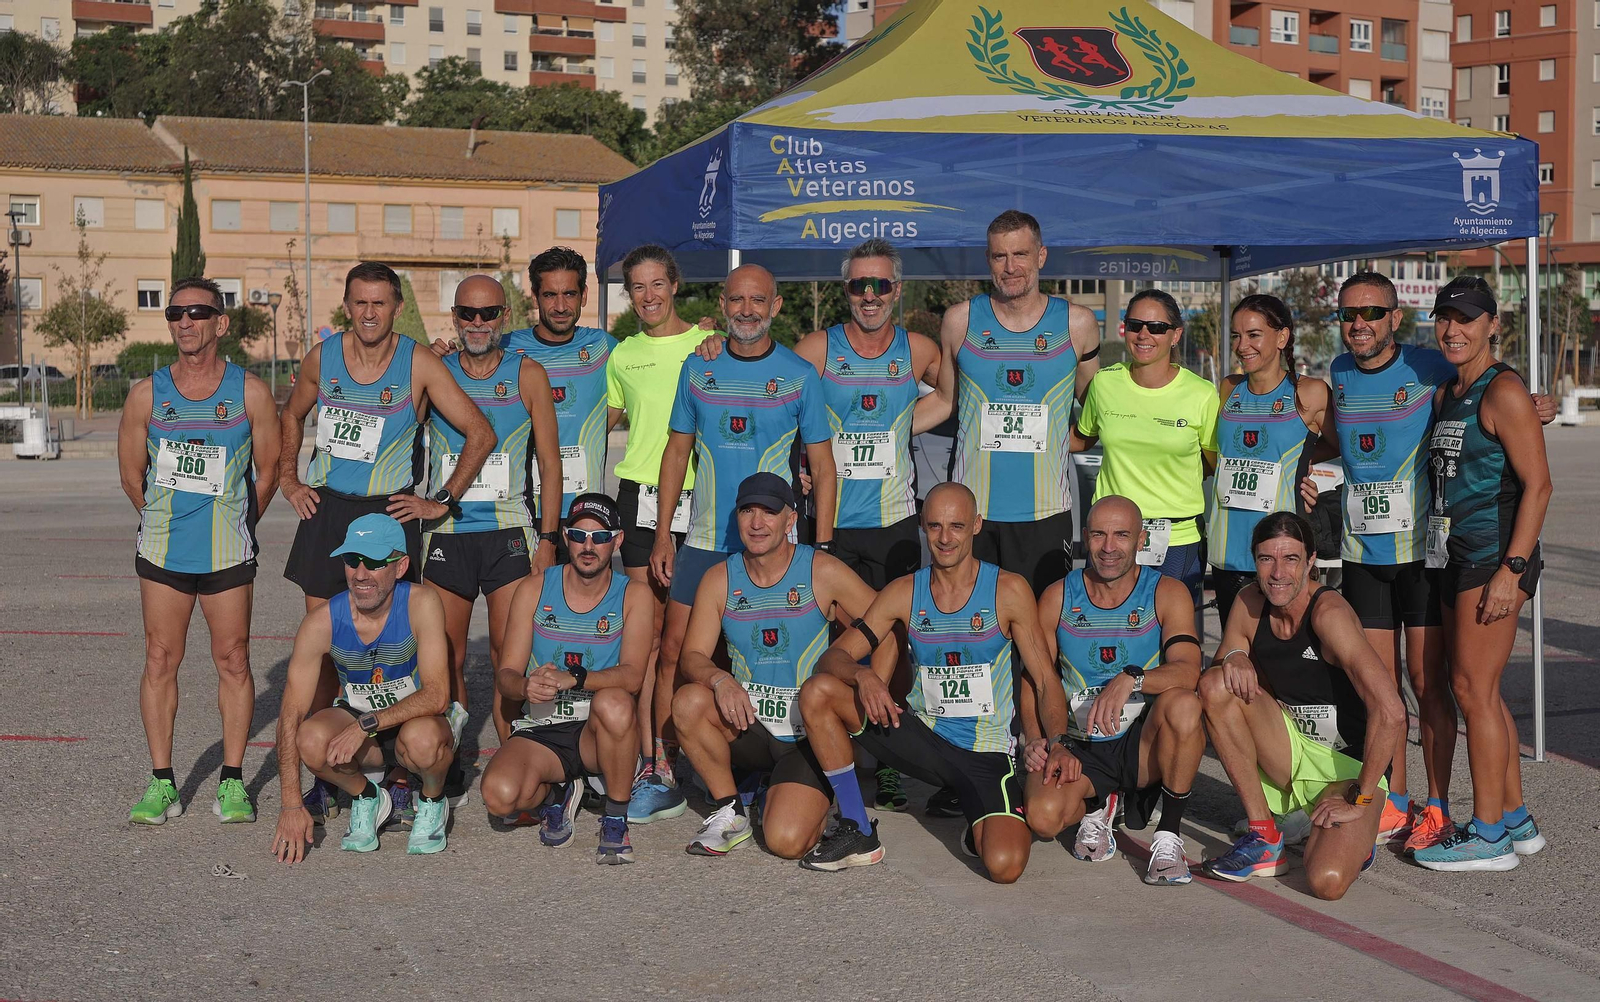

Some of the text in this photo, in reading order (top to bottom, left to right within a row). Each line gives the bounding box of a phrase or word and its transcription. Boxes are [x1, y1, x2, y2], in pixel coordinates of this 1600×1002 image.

[1017, 114, 1127, 126] VETERANOS
[1053, 108, 1180, 122] CLUB ATLETAS
[770, 135, 823, 156] Club
[776, 158, 867, 175] Atletas
[786, 176, 915, 197] Veteranos
[692, 220, 716, 232] Ayuntamiento
[1454, 217, 1513, 227] Ayuntamiento
[698, 231, 714, 240] Algeciras
[800, 217, 918, 244] Algeciras
[1470, 226, 1508, 236] Algeciras
[326, 407, 354, 418] XXVI
[333, 422, 362, 442] 126
[1003, 416, 1024, 434] 34
[166, 441, 195, 450] XXVI
[1443, 439, 1460, 448] PILAR
[851, 445, 875, 462] 177
[176, 456, 206, 476] 160
[1226, 459, 1250, 467] XXVI
[187, 473, 208, 481] RODRIGUEZ
[1232, 472, 1258, 491] 188
[1353, 483, 1376, 491] XXVI
[1362, 495, 1390, 514] 195
[748, 684, 775, 694] XXVI
[939, 680, 970, 698] 124
[366, 692, 399, 709] 136
[555, 701, 574, 716] 15
[757, 699, 786, 718] 166
